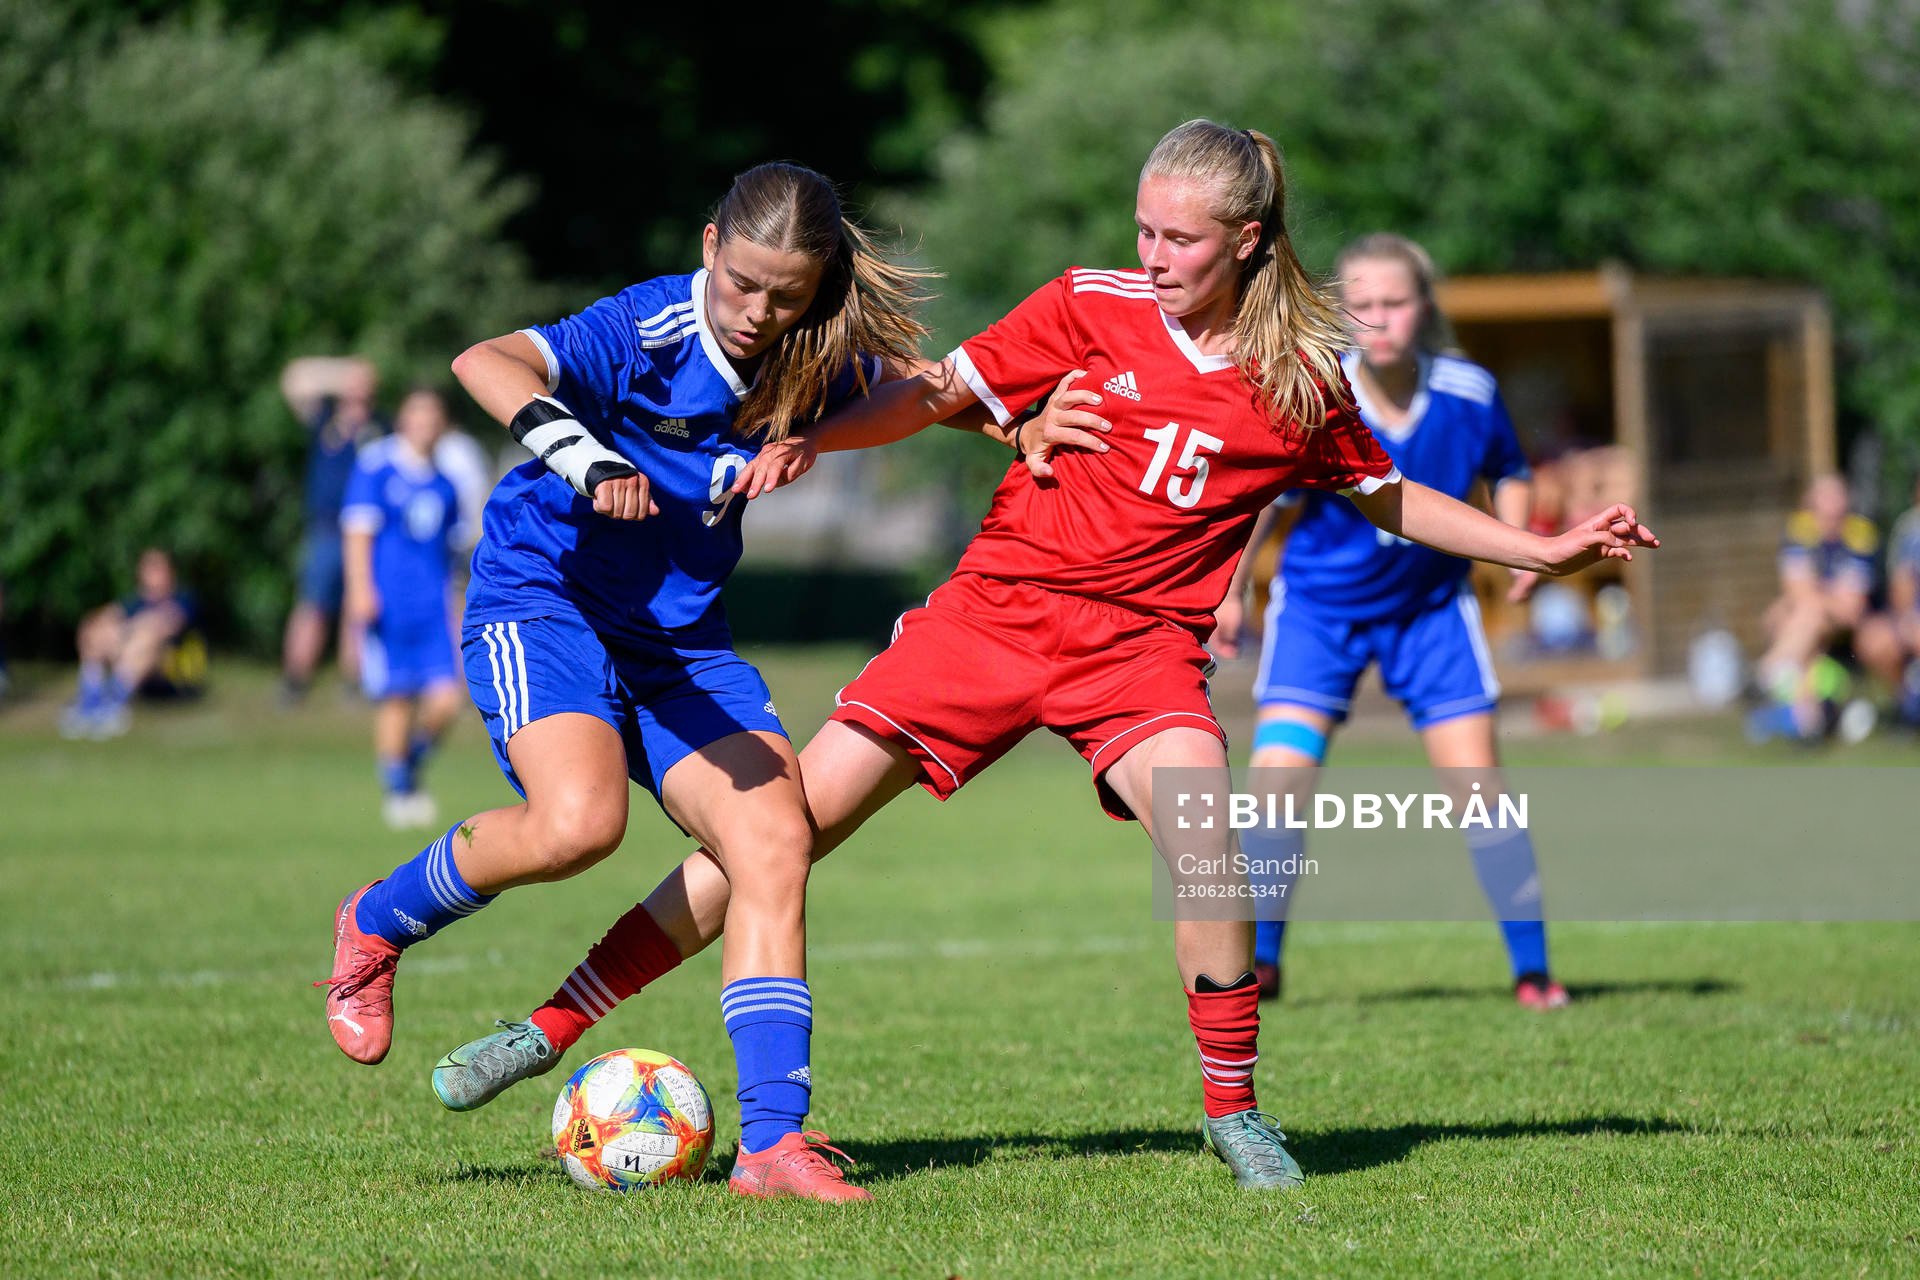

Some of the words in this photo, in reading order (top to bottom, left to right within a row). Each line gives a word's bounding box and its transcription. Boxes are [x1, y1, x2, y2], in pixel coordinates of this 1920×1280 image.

[1103, 380, 1142, 402] adidas
[654, 424, 690, 439] adidas
[1138, 421, 1225, 509] 15
[702, 454, 748, 527] 9
